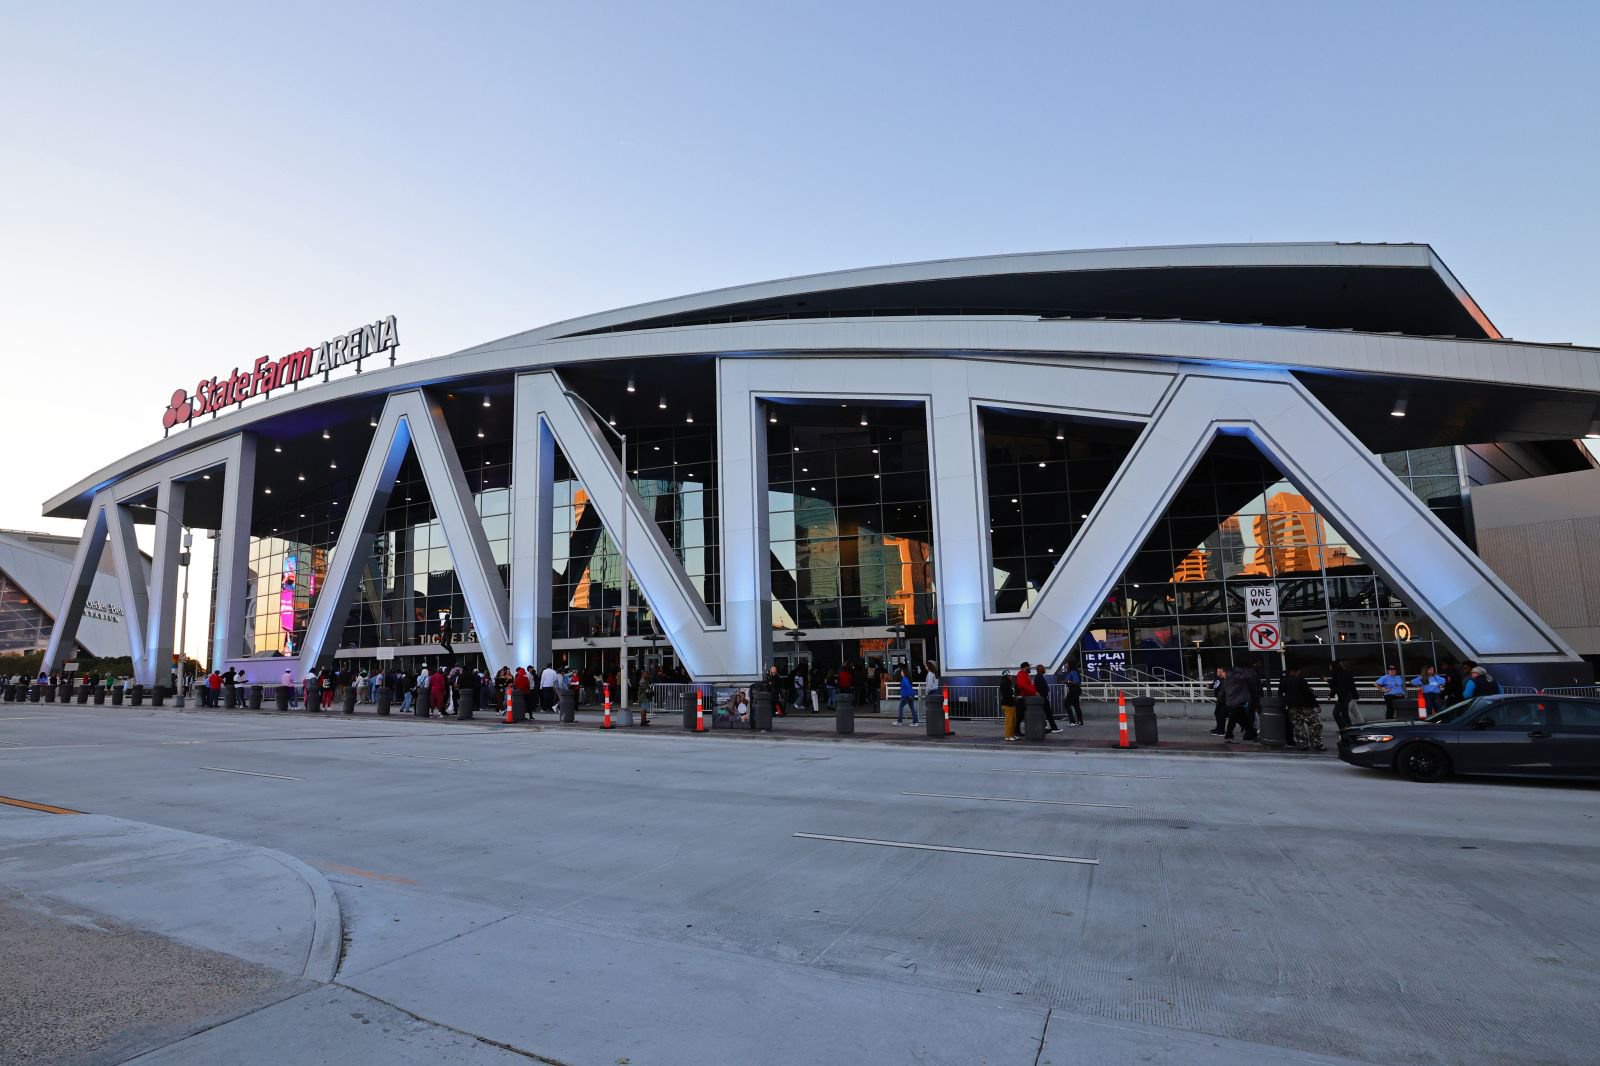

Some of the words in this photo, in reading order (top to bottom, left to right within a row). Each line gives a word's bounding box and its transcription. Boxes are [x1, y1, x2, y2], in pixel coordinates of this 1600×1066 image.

[192, 367, 250, 417] State
[250, 347, 313, 397] Farm
[315, 315, 400, 375] ARENA
[1250, 588, 1272, 597] ONE
[1250, 598, 1272, 606] WAY
[418, 630, 476, 645] TICETS
